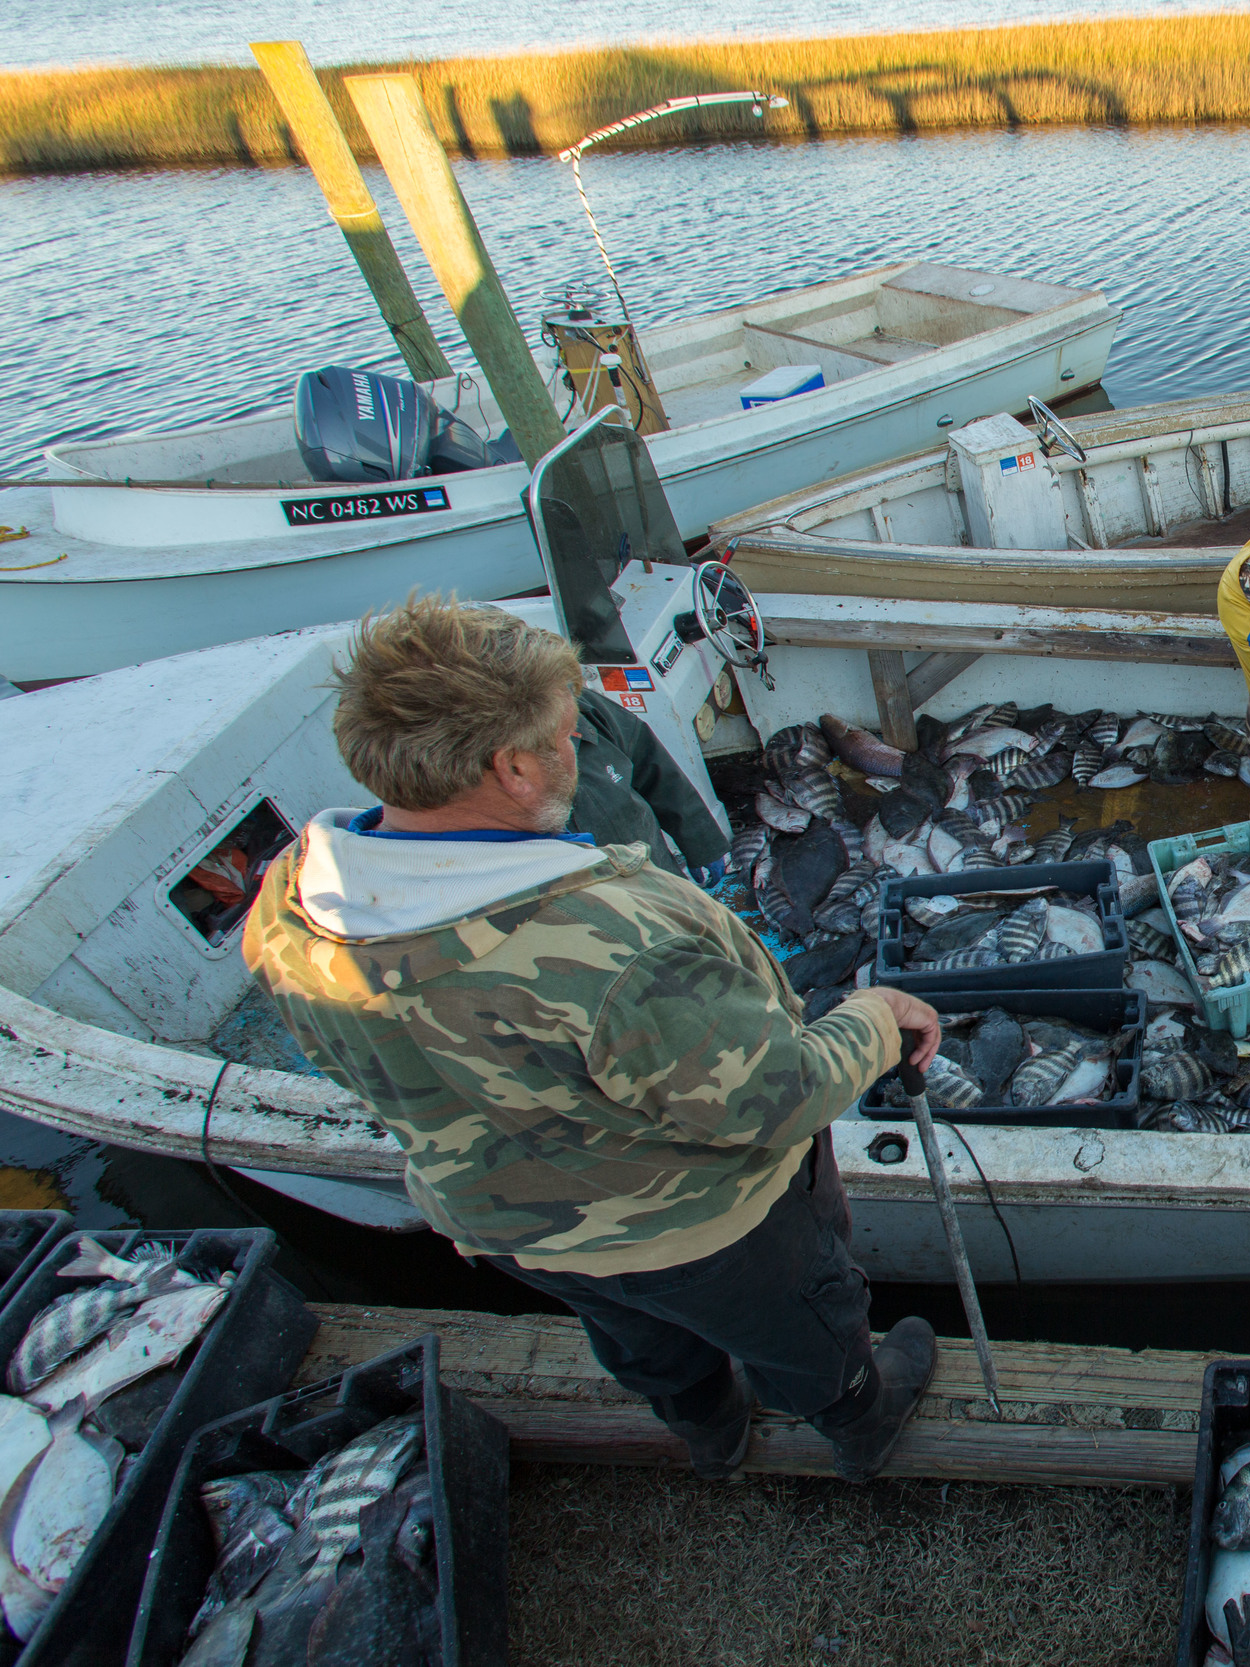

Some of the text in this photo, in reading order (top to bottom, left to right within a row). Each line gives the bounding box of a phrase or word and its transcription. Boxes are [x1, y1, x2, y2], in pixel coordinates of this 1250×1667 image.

[352, 373, 376, 421] YAMAHA
[1020, 455, 1032, 466] 18
[292, 503, 325, 520] NC
[385, 494, 418, 512] WS
[623, 696, 641, 706] 18
